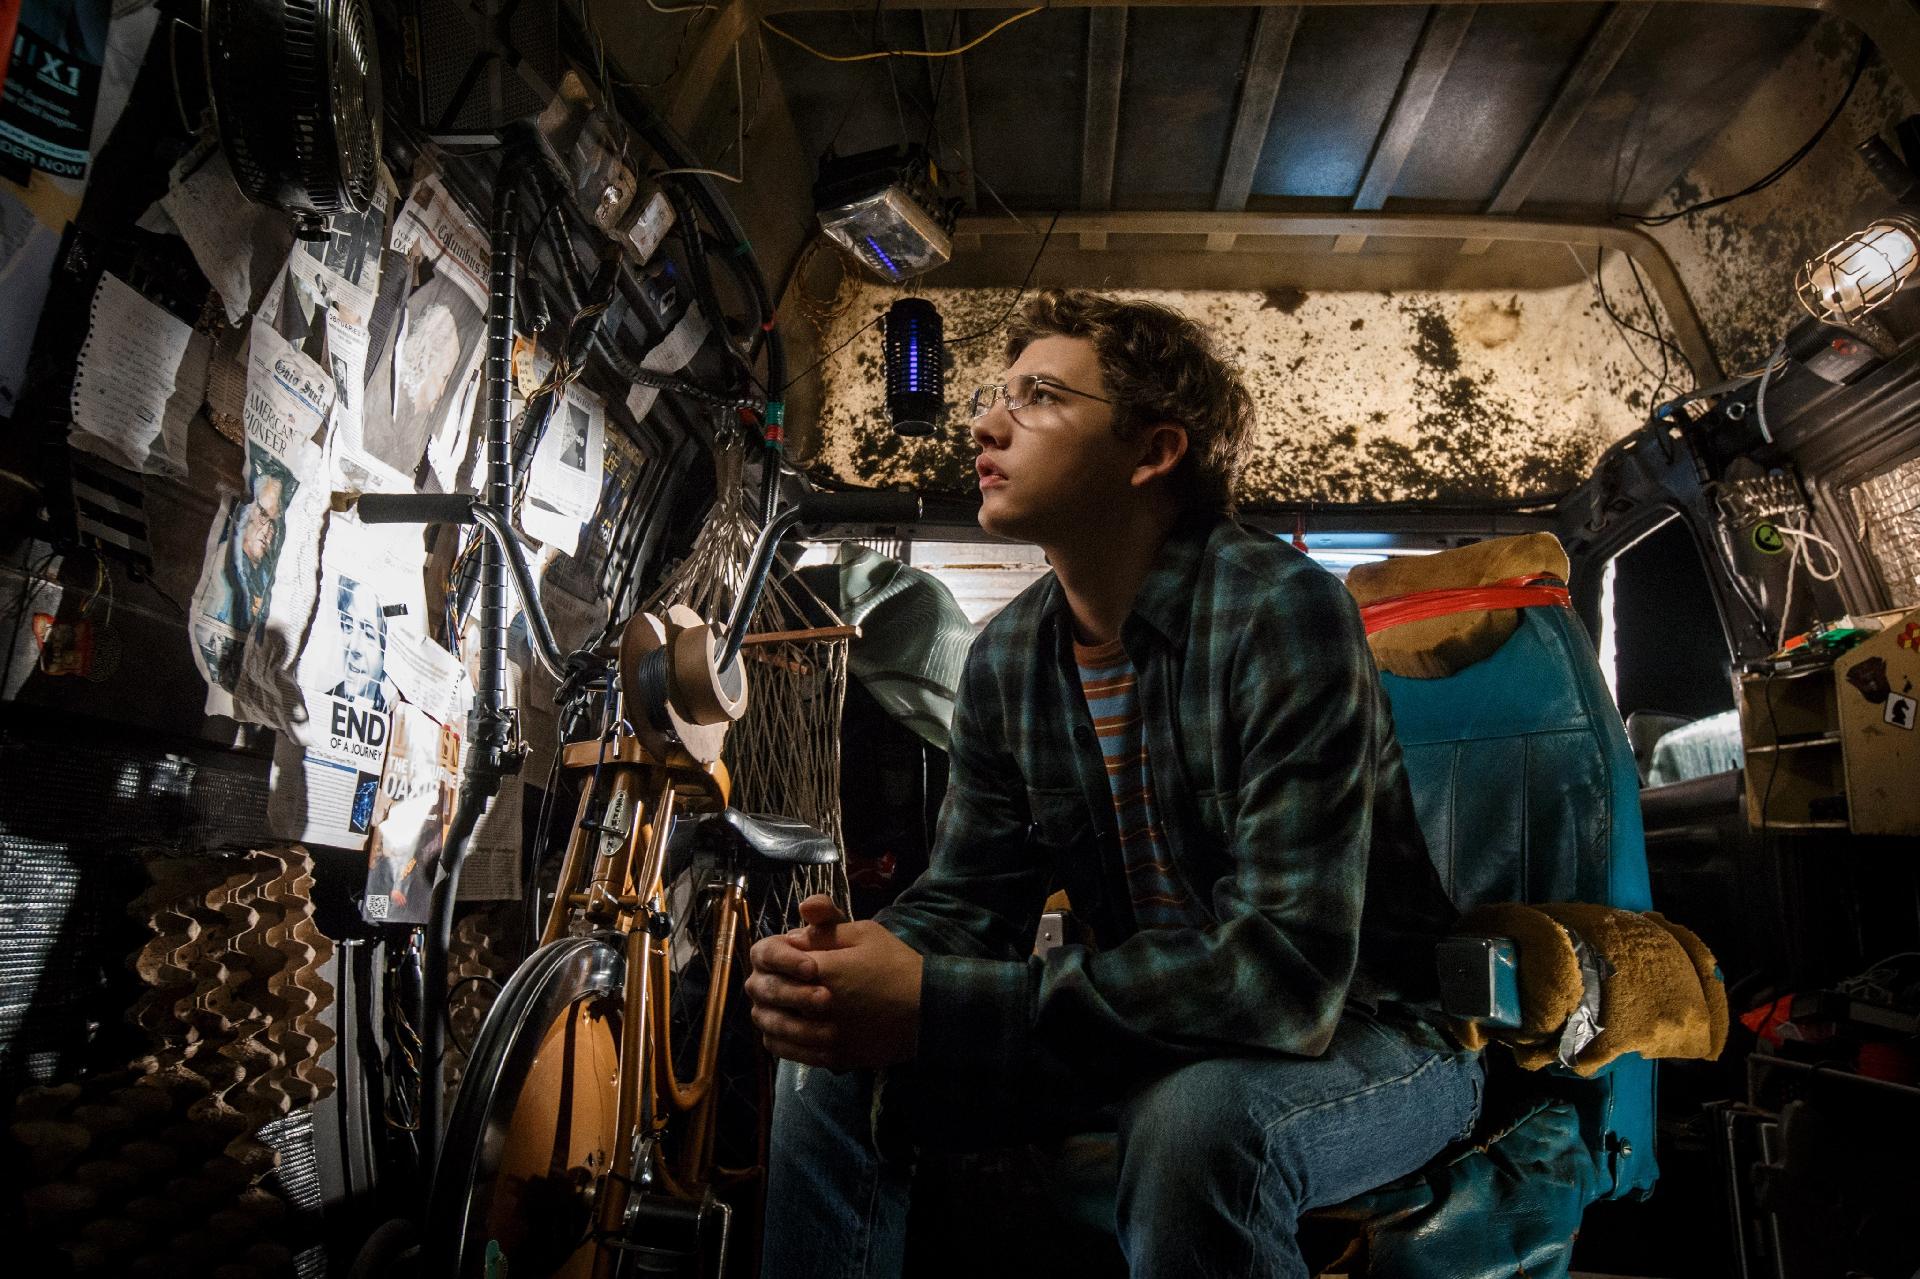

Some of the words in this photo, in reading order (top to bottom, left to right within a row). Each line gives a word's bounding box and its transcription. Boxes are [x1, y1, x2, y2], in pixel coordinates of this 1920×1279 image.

[38, 156, 82, 175] NOW
[438, 224, 481, 274] Columbus
[244, 408, 288, 458] PIONEER
[249, 392, 299, 445] AMERICAN
[331, 701, 387, 747] END
[330, 737, 342, 749] OF
[343, 742, 350, 752] A
[351, 743, 383, 761] JOURNEY
[388, 755, 409, 774] THE
